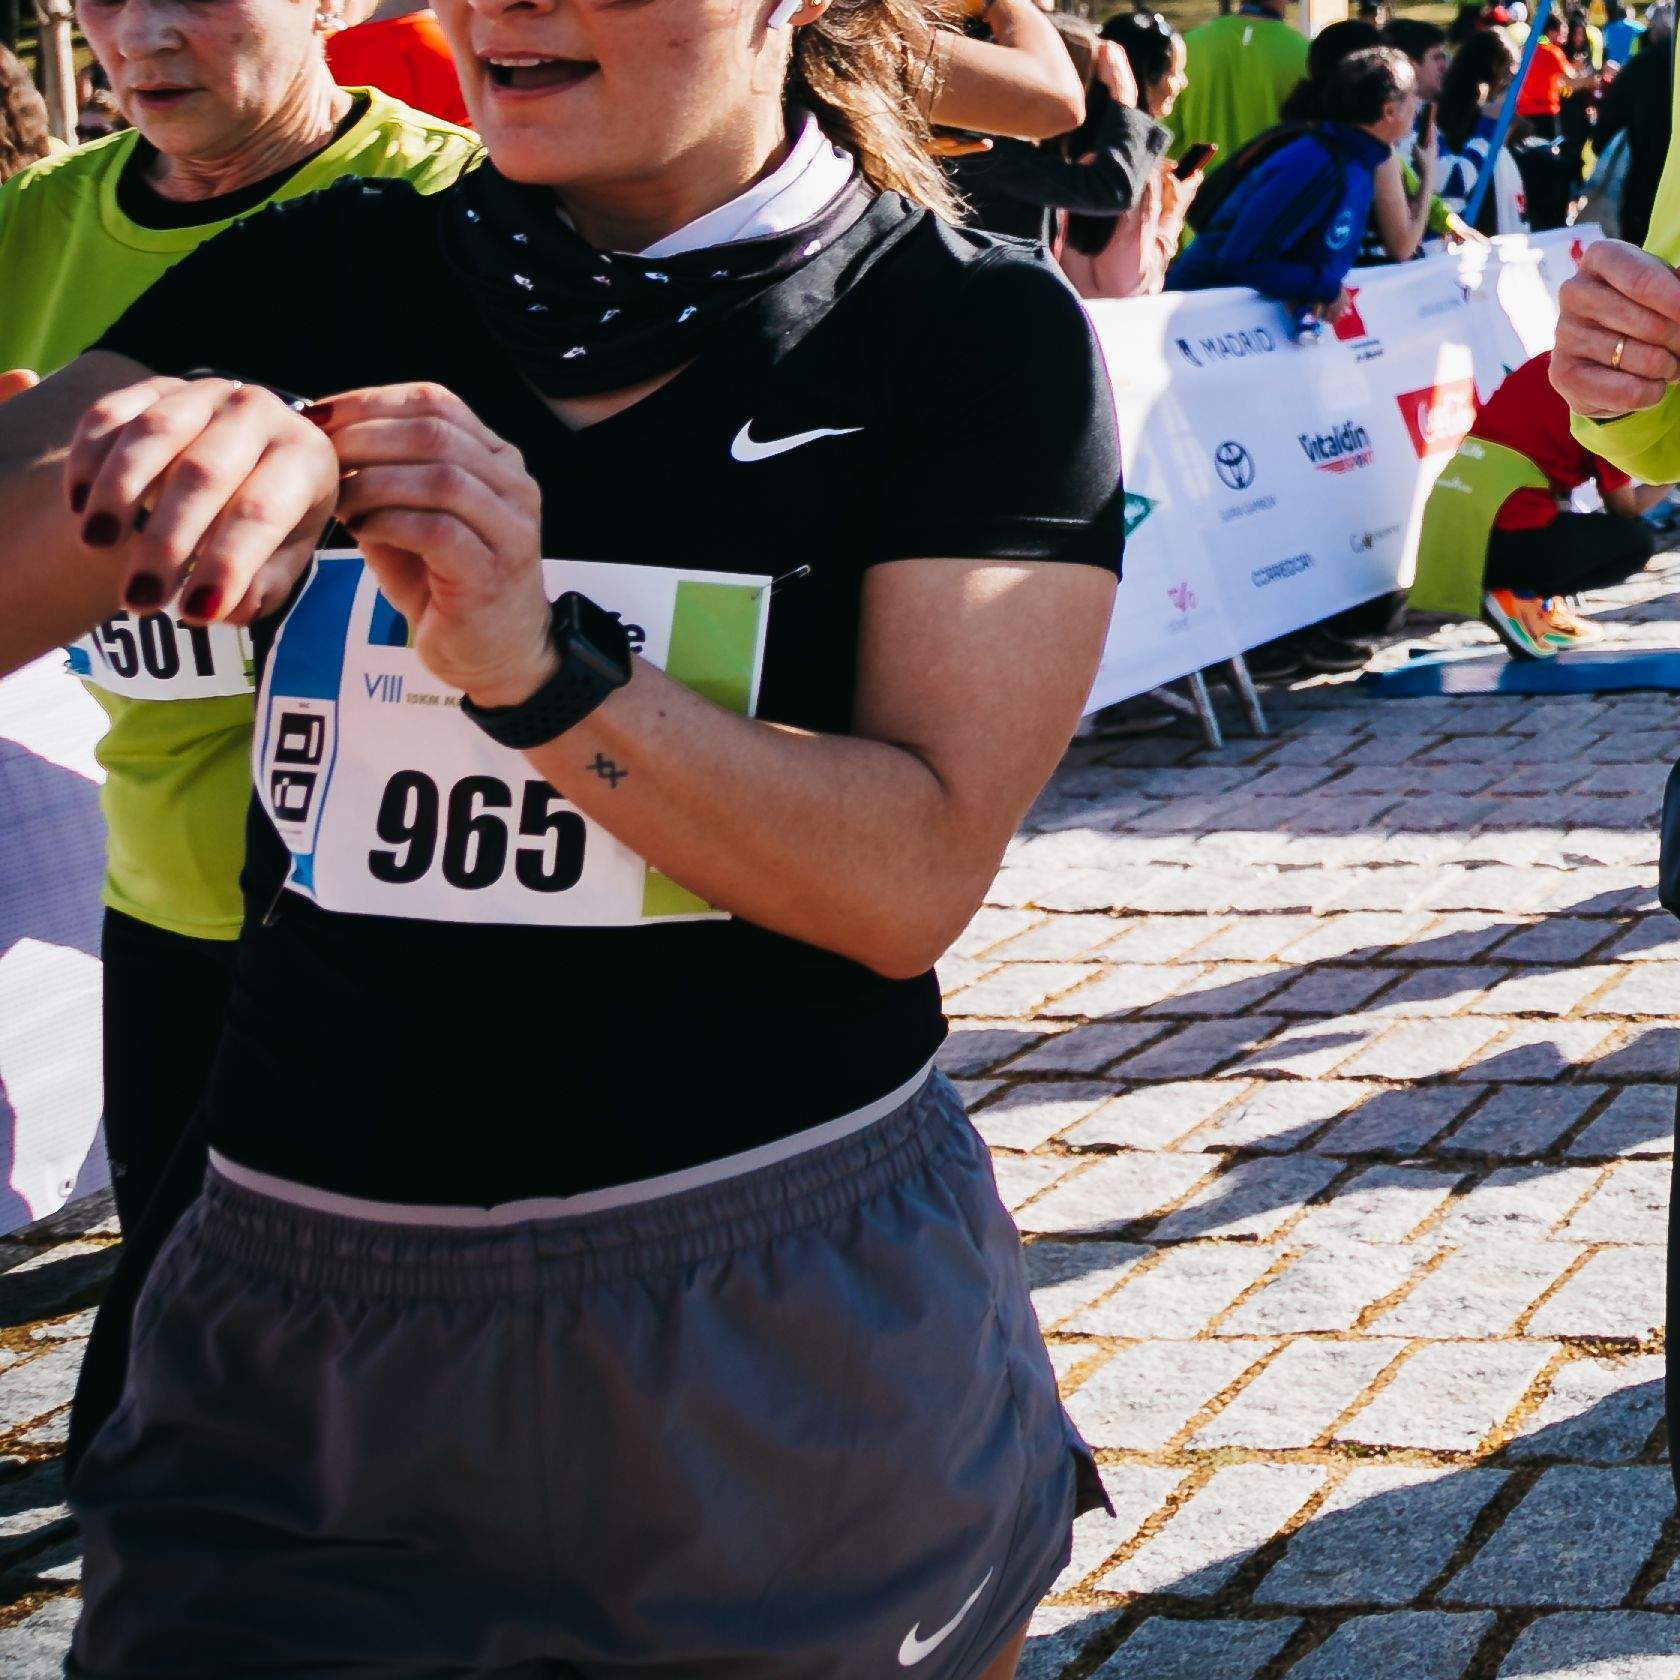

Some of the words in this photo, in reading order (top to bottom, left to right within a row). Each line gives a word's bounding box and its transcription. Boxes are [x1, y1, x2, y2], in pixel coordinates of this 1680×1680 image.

[1199, 327, 1276, 361] MADRID
[92, 609, 216, 680] 501
[363, 672, 404, 704] VIII
[368, 769, 587, 893] 965
